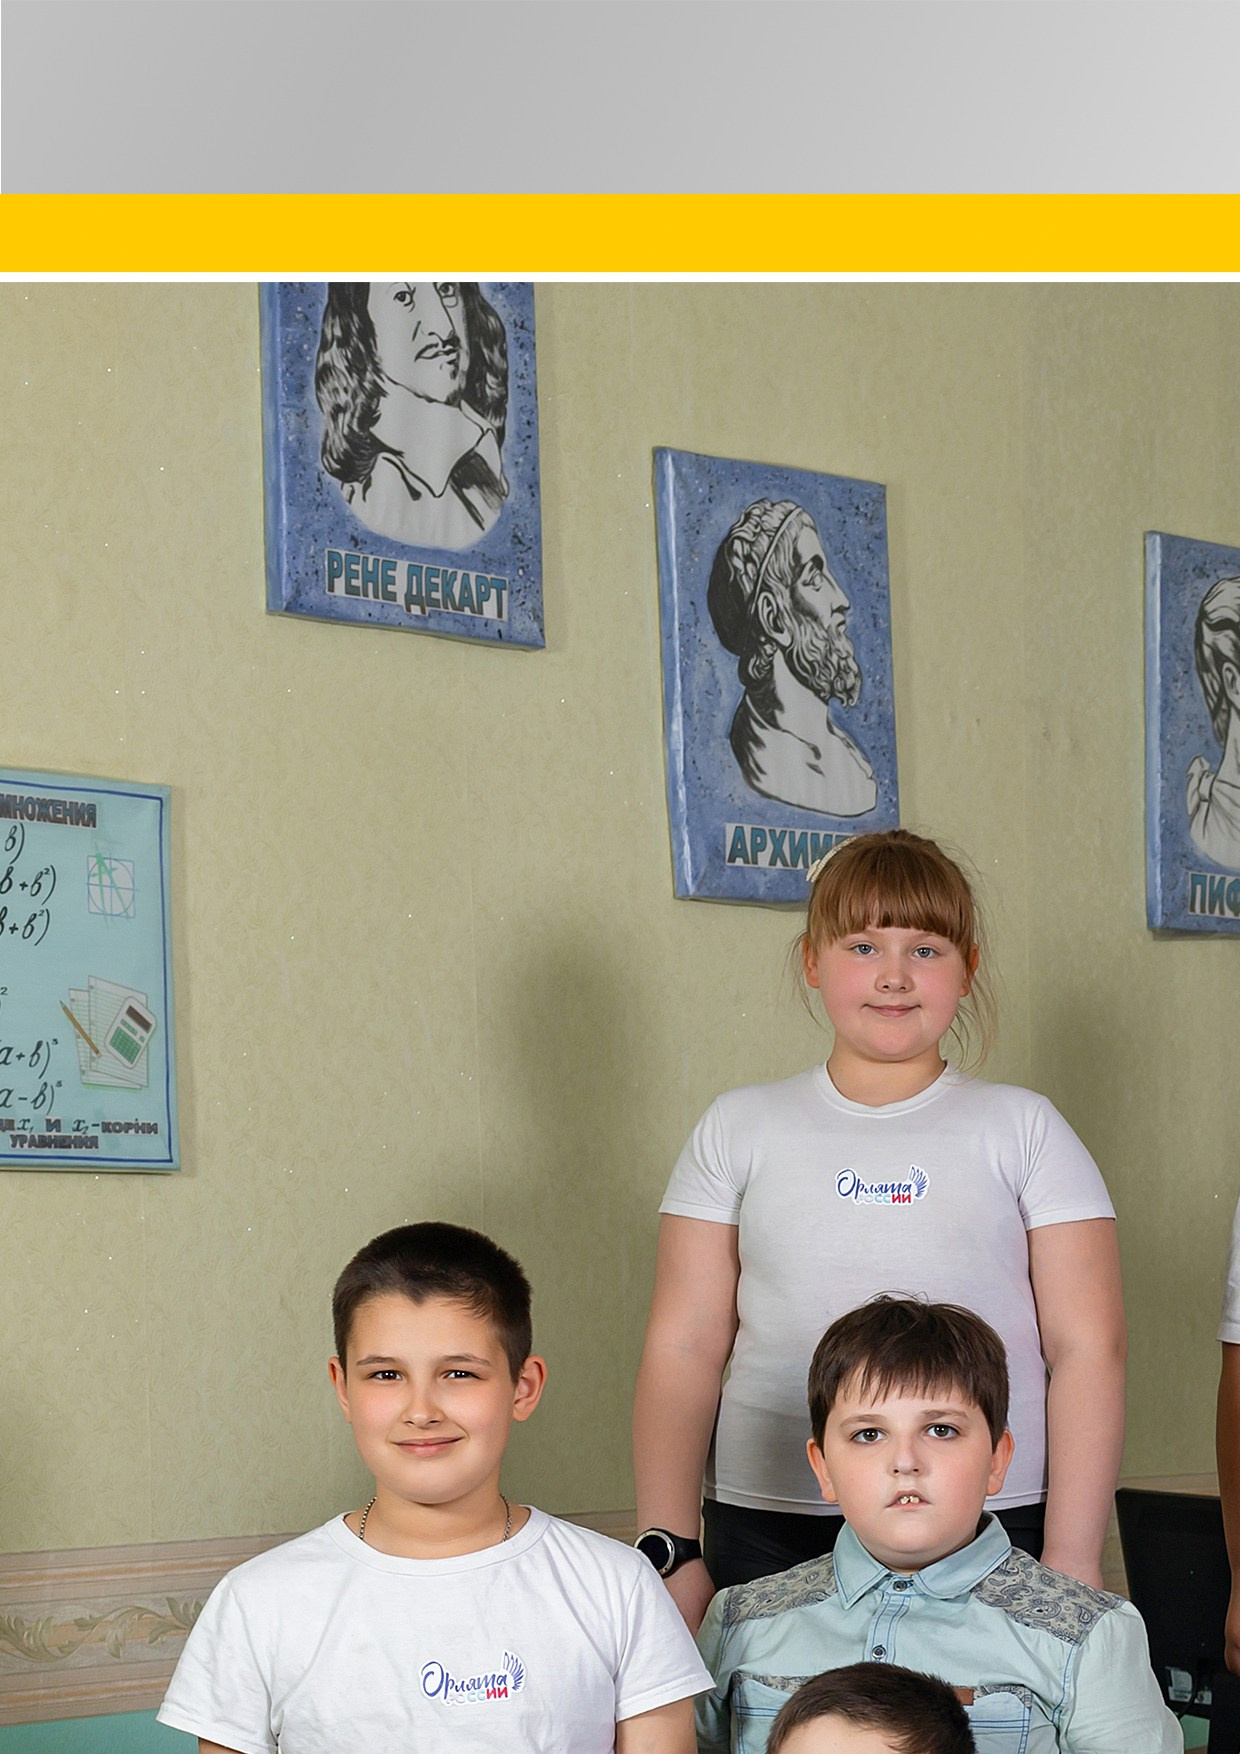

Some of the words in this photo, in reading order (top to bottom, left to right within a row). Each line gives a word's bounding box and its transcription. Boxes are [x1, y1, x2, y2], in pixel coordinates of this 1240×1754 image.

[327, 550, 397, 602] РЕНЕ
[404, 563, 507, 619] ДЕКАРТ
[727, 826, 848, 868] АРХИМ
[10, 1134, 98, 1149] УРАВНЕНИЯ
[837, 1168, 912, 1199] Орлята
[421, 1661, 508, 1699] Орлята
